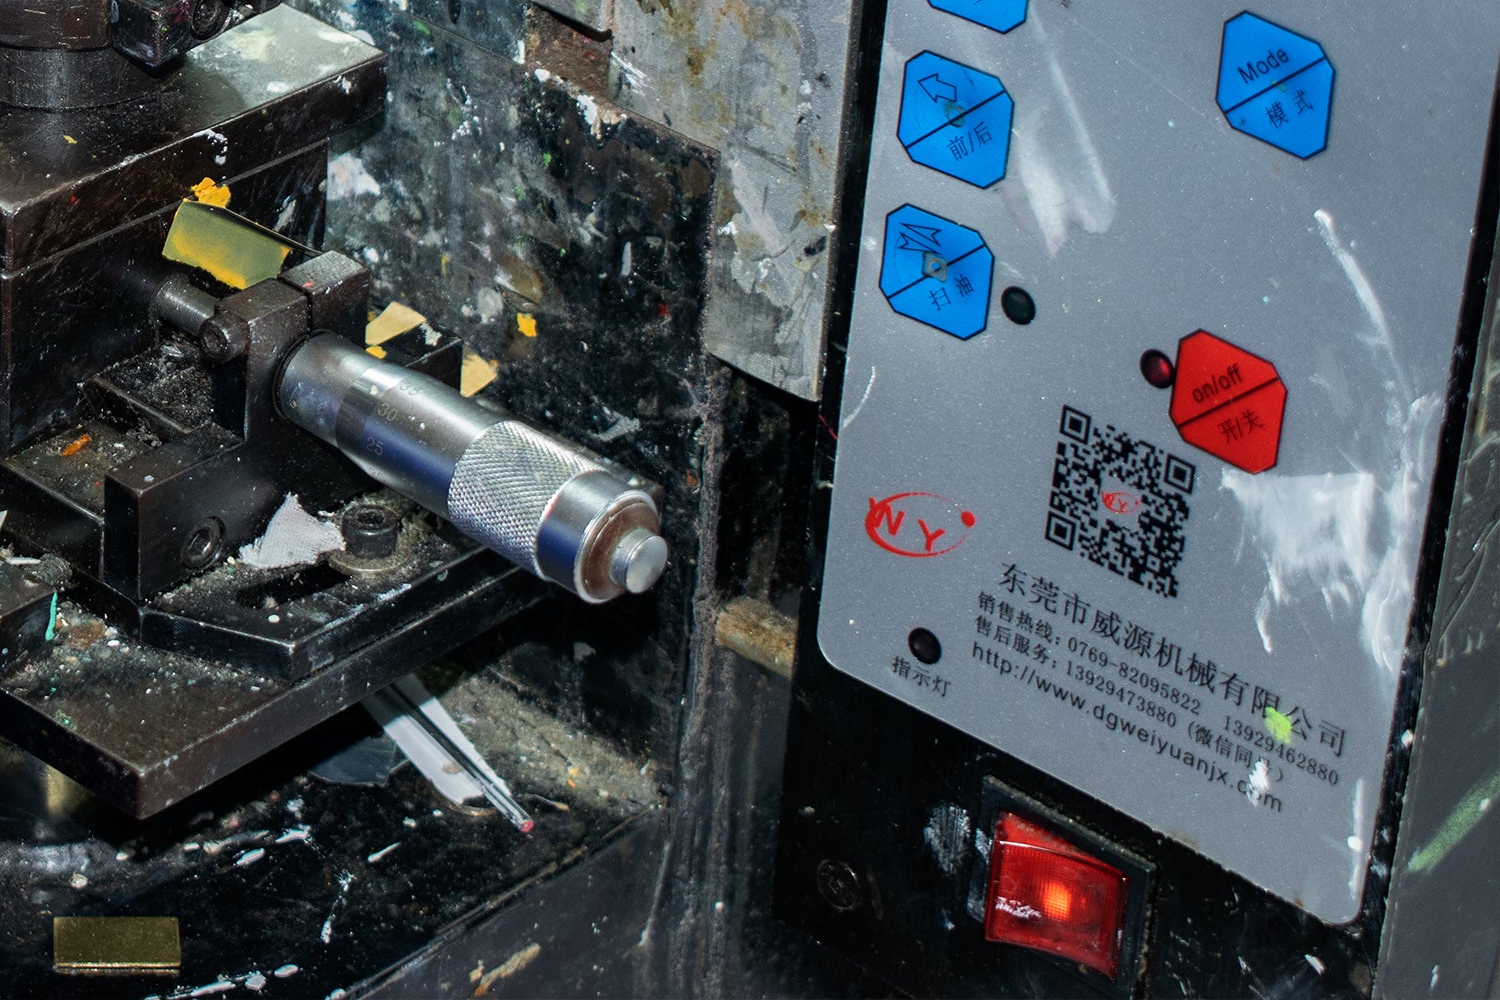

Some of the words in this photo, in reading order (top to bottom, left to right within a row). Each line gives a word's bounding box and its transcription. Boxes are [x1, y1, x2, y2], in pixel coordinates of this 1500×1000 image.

[1236, 49, 1290, 85] Mode
[1265, 89, 1314, 129] 模式
[946, 120, 994, 162] 前/后
[929, 273, 975, 311] 扫油
[1191, 363, 1243, 404] on/off
[1218, 408, 1264, 443] 开/关
[891, 655, 952, 698] 指示灯
[997, 562, 1346, 758] 东莞市威源机械有限公司
[971, 641, 1283, 813] http://www.dgweiyuanjx.cm
[1223, 714, 1340, 787] 13929462880
